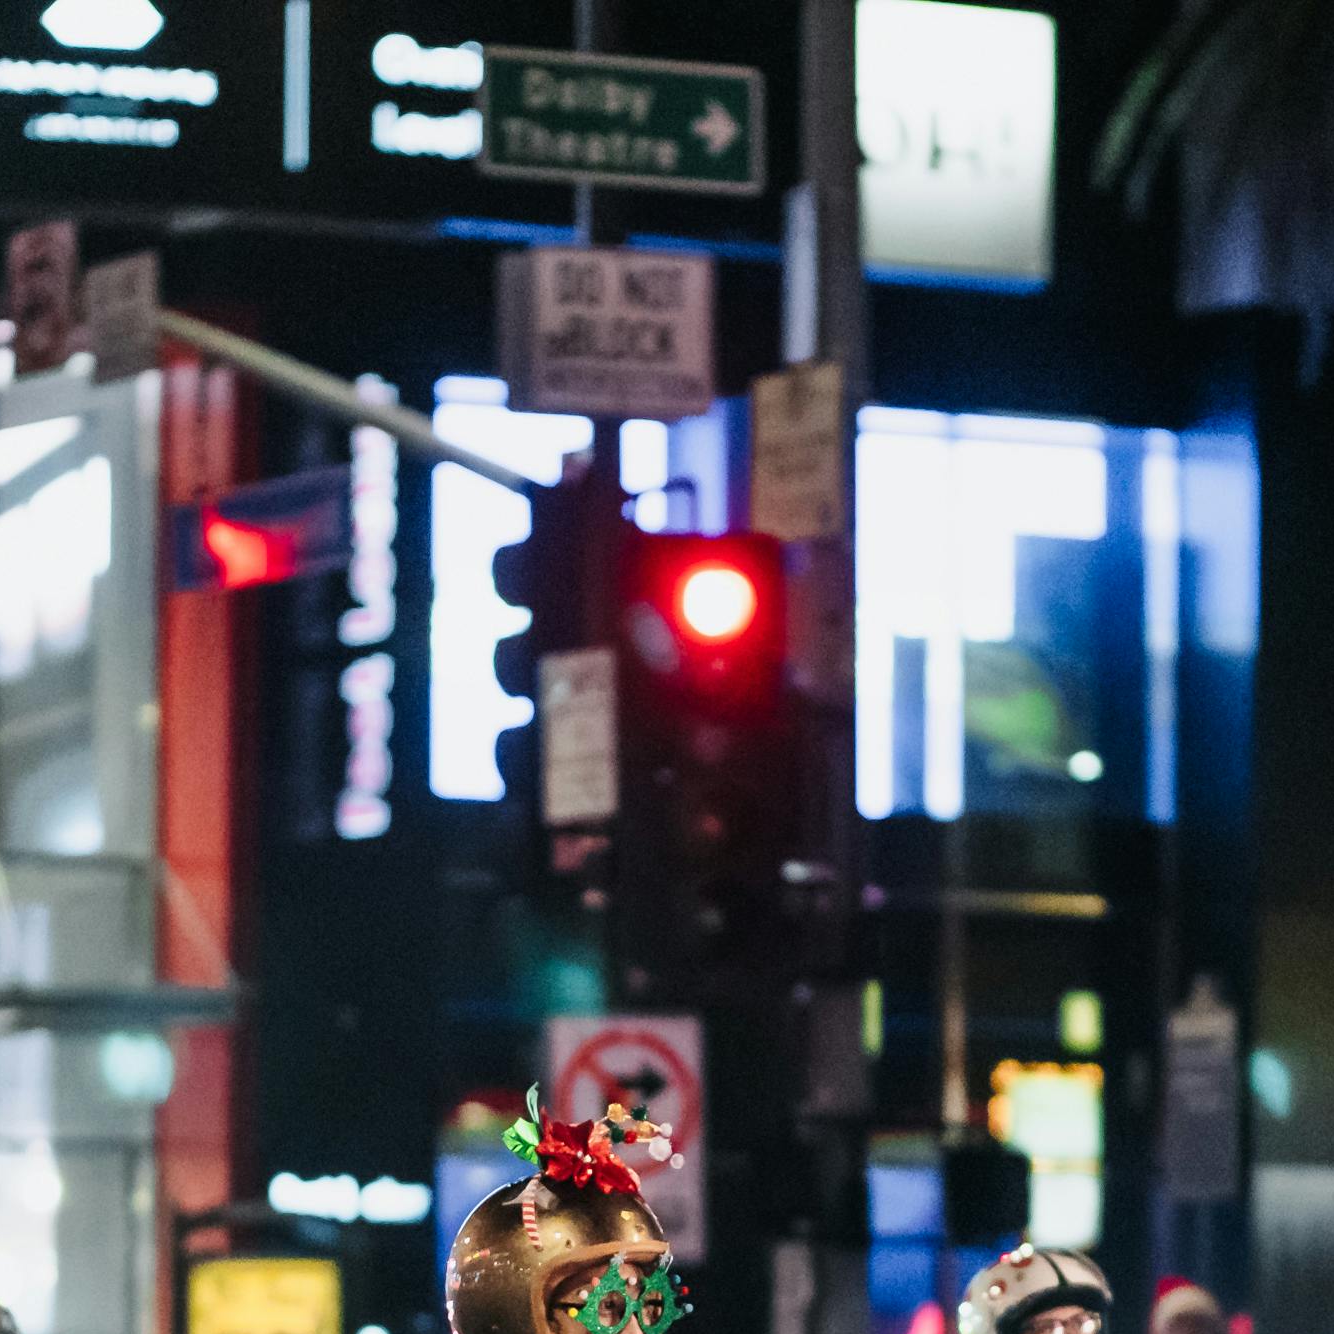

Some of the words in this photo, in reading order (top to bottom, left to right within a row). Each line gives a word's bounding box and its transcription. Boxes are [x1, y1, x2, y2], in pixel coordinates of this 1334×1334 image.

[521, 66, 652, 124] Dolby
[501, 114, 681, 172] Theatre
[622, 265, 687, 312] NOT
